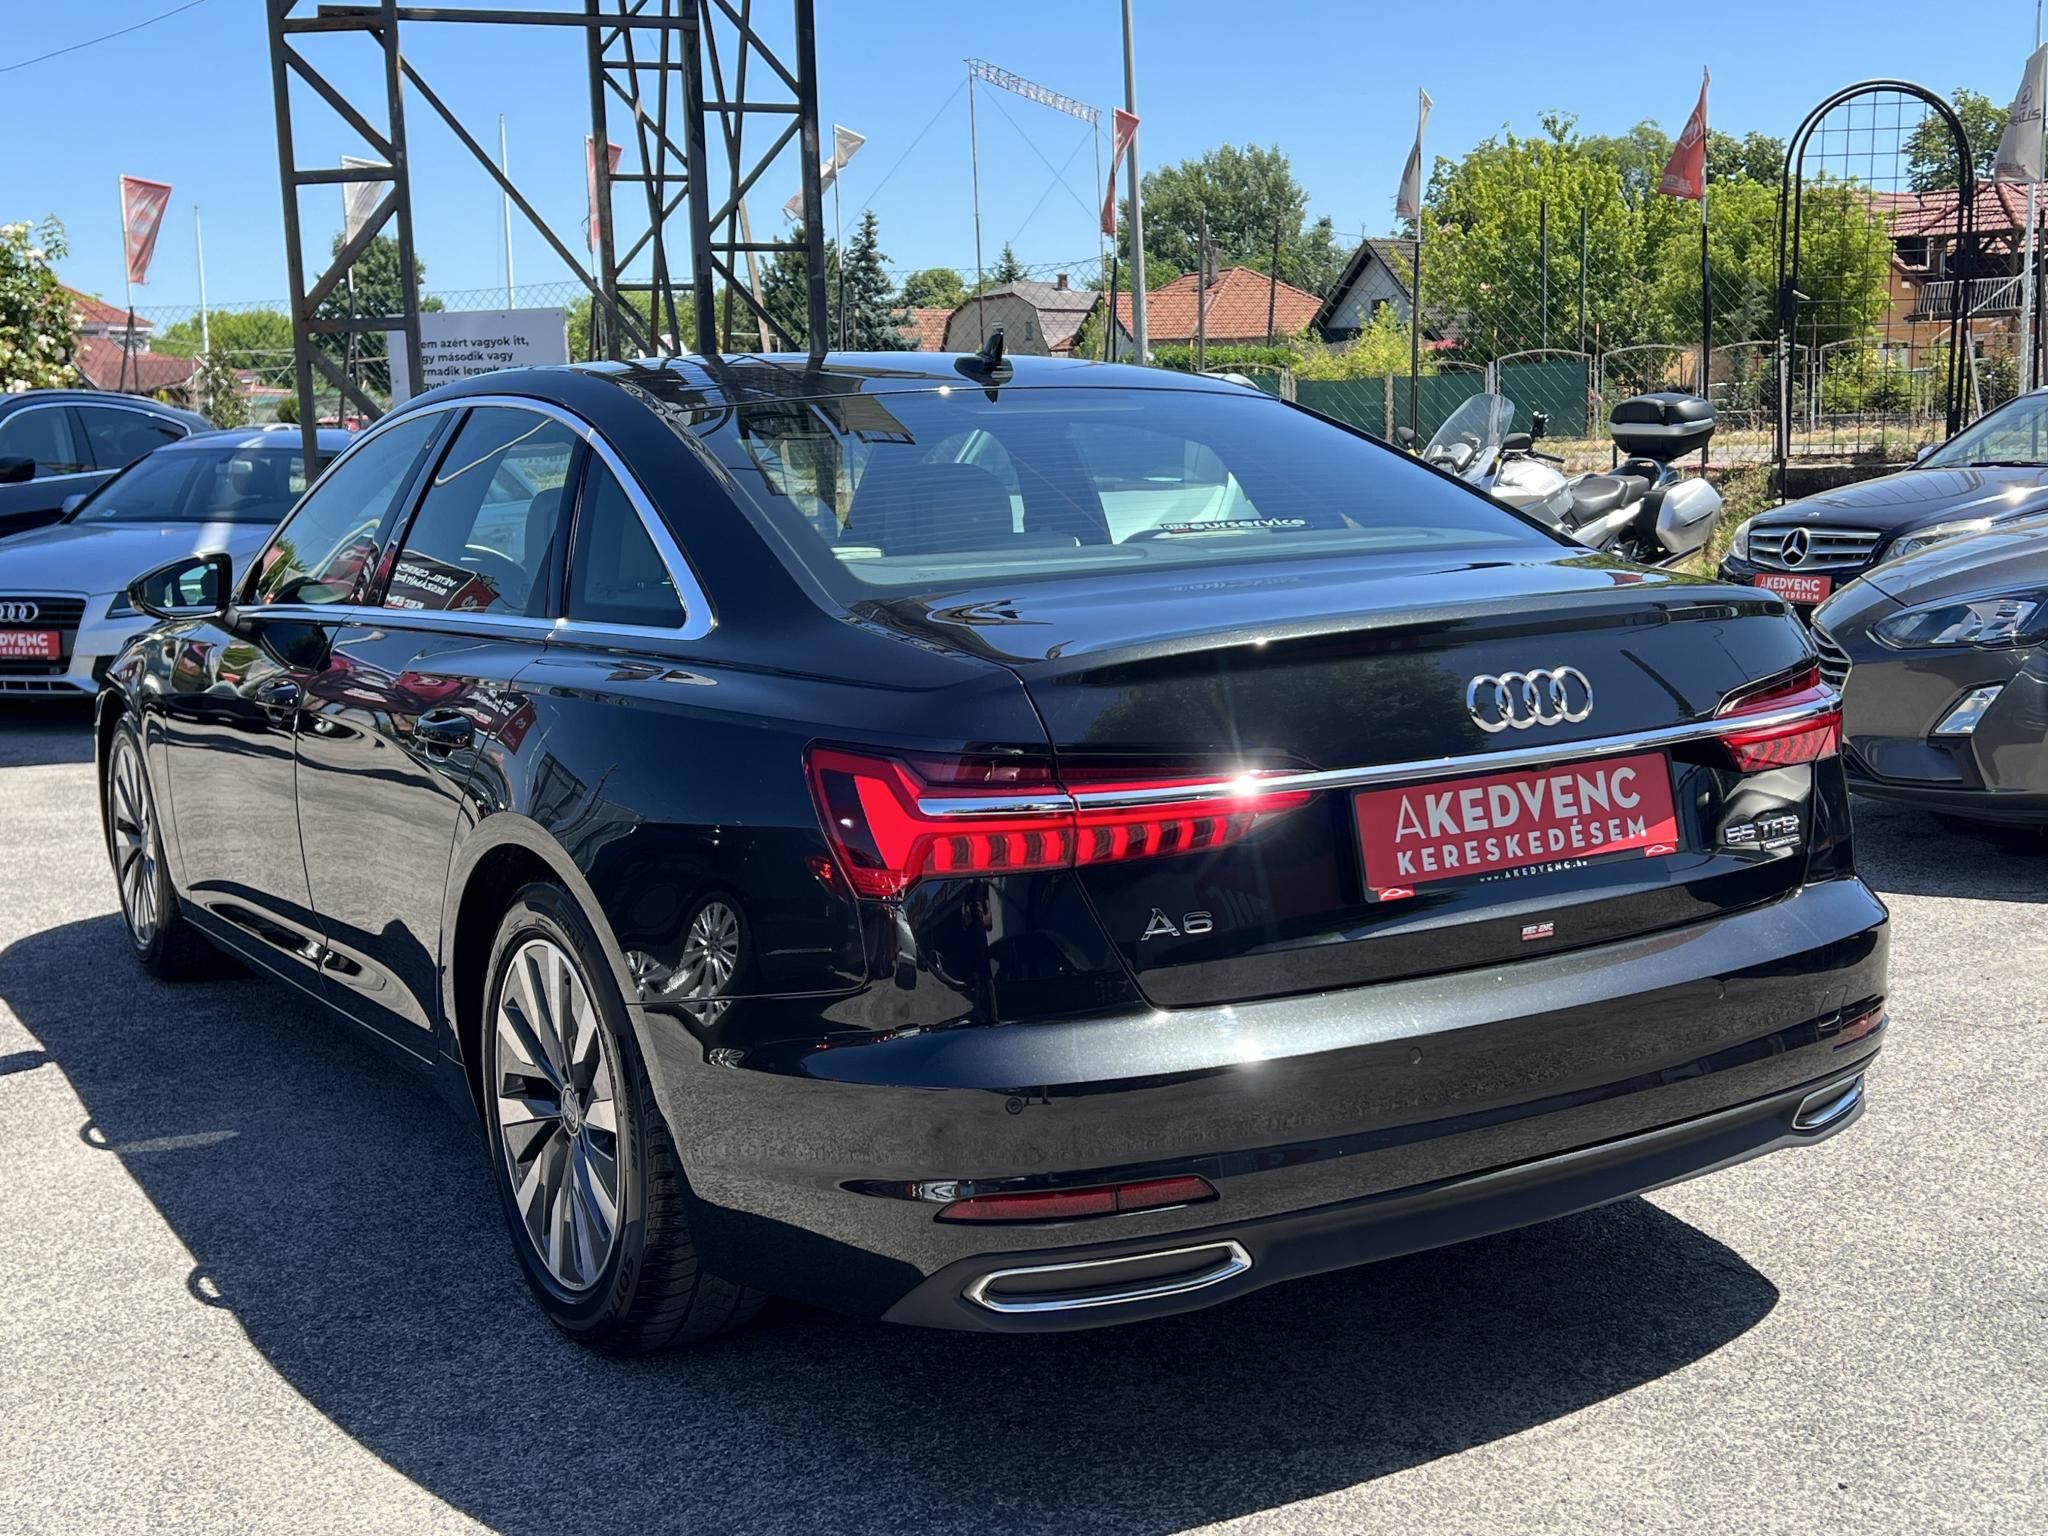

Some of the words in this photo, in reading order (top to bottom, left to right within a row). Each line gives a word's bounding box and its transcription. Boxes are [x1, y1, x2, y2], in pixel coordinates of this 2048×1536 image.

[420, 341, 437, 349] em
[440, 338, 468, 348] azért
[470, 336, 510, 349] vagyok
[438, 351, 484, 363] második
[486, 352, 513, 362] vagy
[423, 366, 460, 376] rmadik
[1760, 576, 1820, 592] AKEDVENC
[1395, 767, 1640, 843] AKEDVENC
[1397, 816, 1647, 875] KERESKEDÉSEM
[1140, 907, 1213, 941] A6
